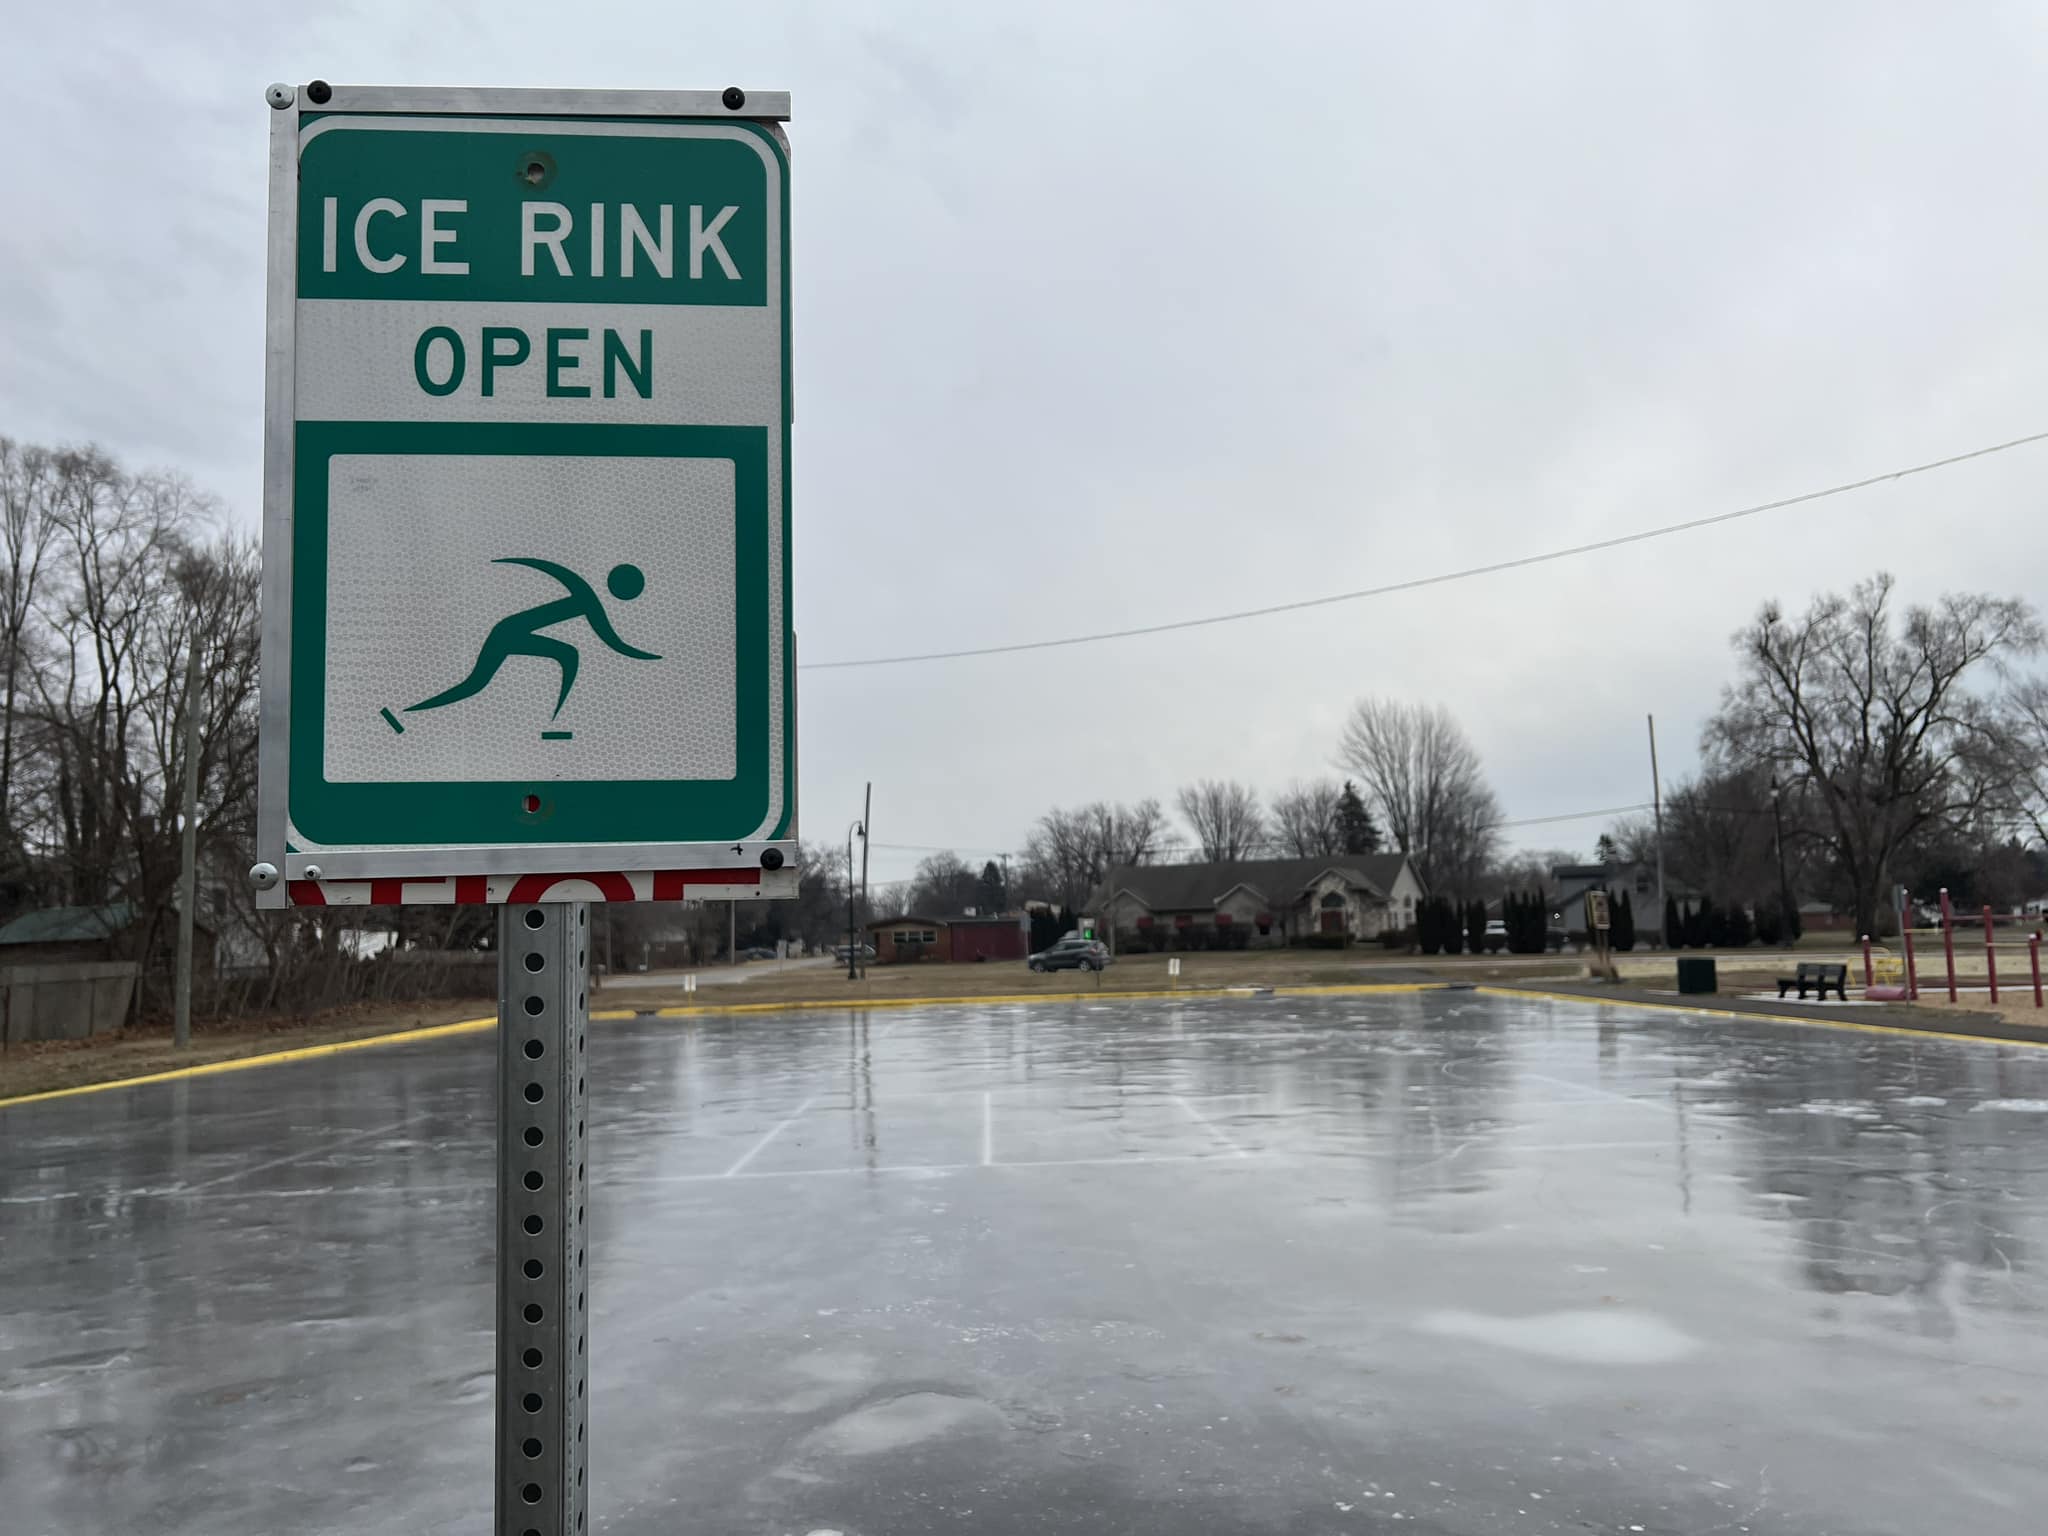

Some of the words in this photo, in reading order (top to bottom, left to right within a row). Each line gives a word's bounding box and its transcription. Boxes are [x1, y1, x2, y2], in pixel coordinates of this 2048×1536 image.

[323, 197, 470, 275] ICE
[520, 201, 742, 279] RINK
[414, 326, 653, 399] OPEN
